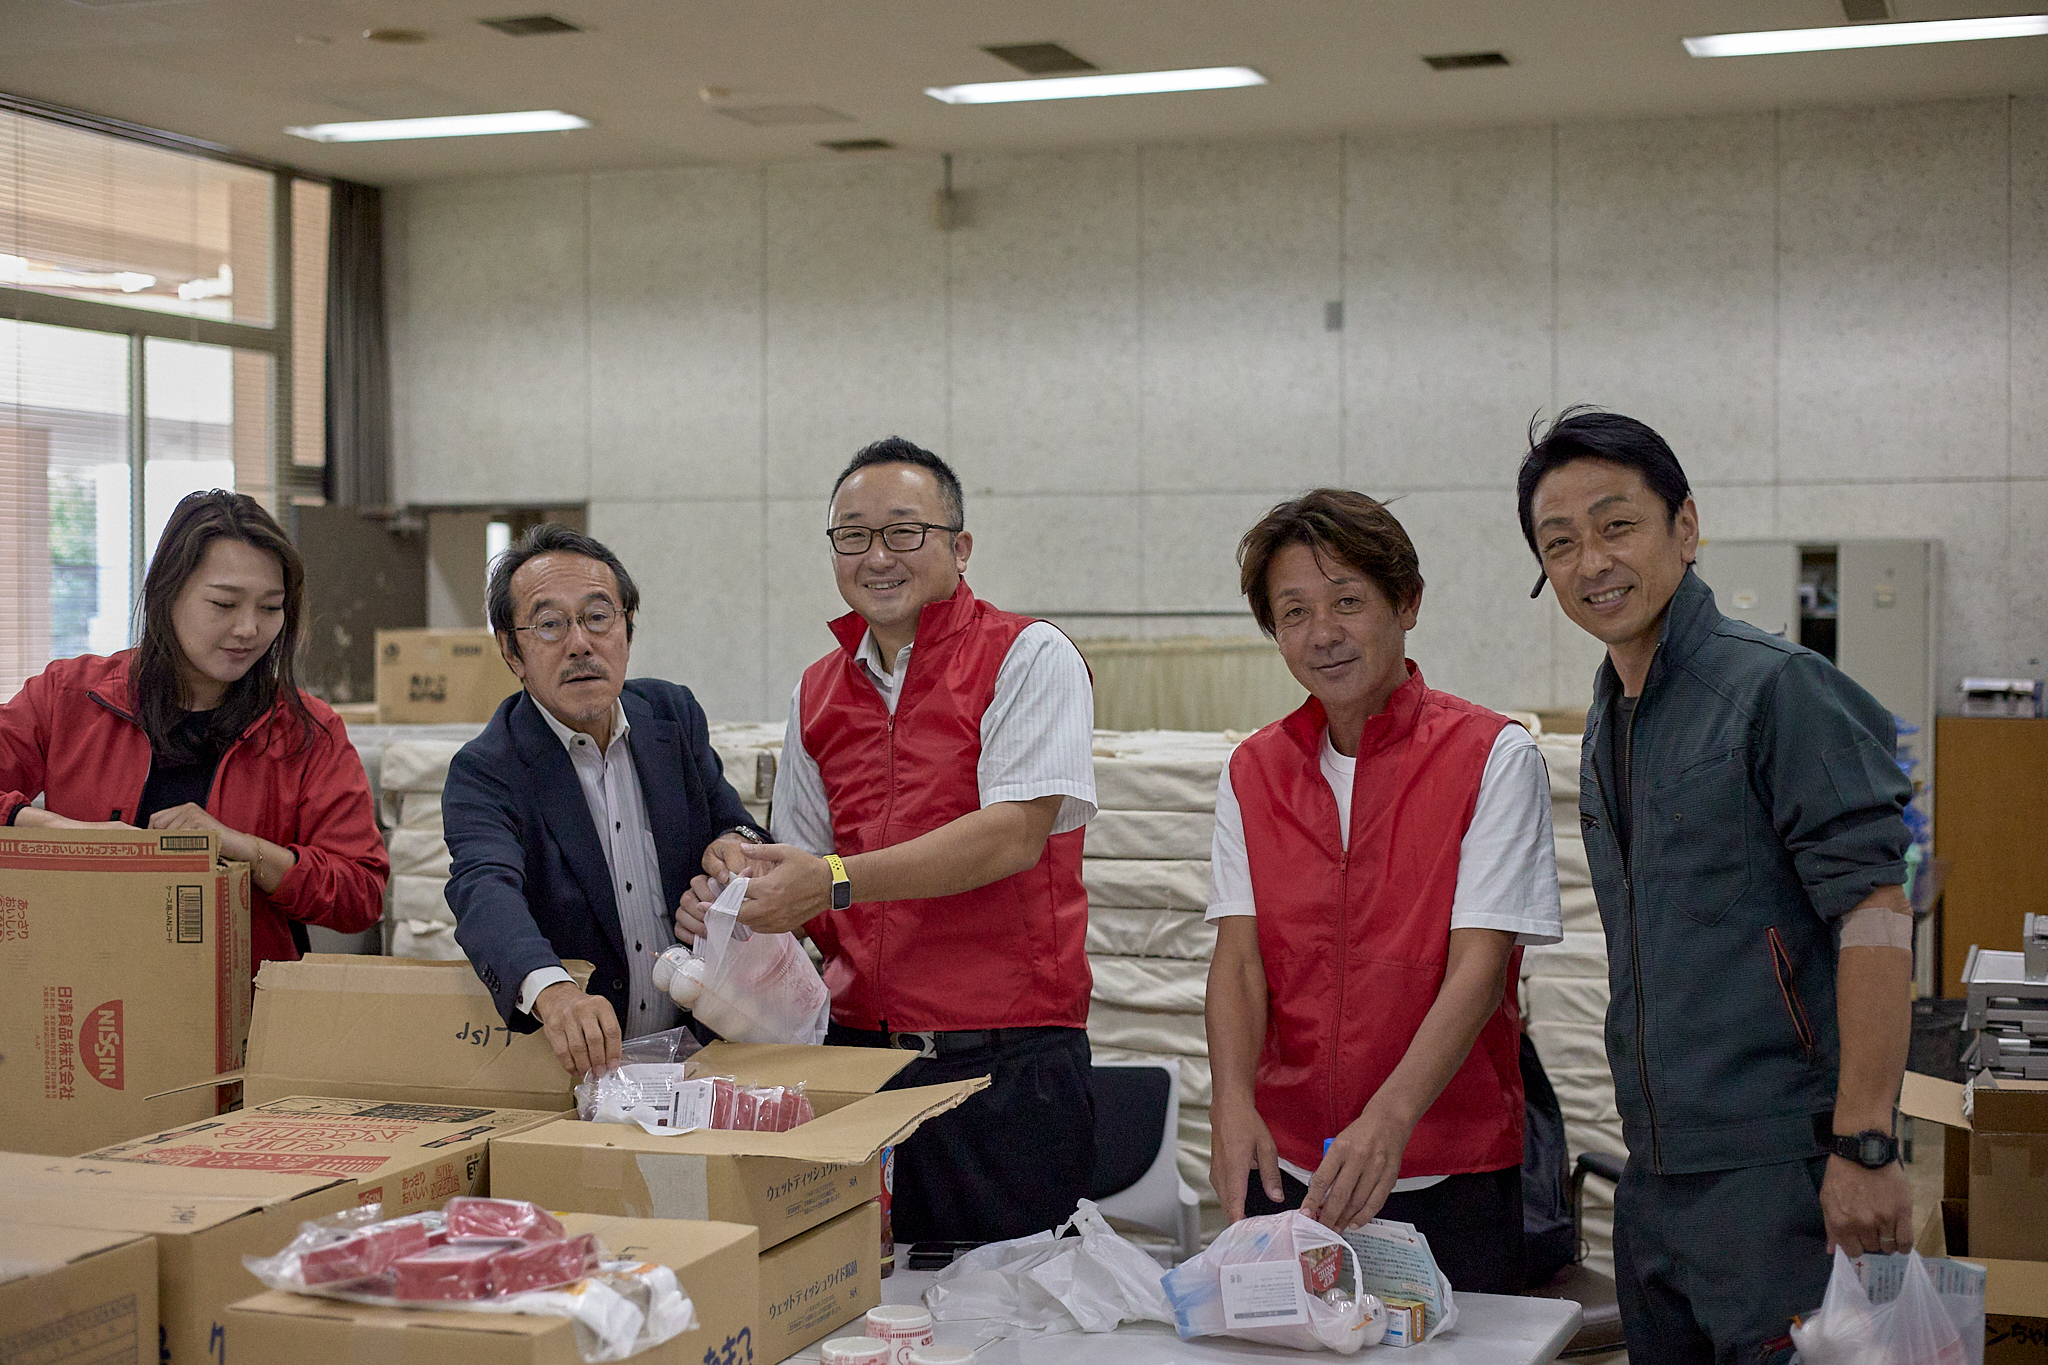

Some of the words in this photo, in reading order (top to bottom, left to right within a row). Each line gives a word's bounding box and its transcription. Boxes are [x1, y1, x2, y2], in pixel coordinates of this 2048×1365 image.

[21, 843, 137, 856] あっさりおいしいカップヌードル
[5, 896, 17, 942] おいしい
[17, 898, 30, 940] あっさり
[165, 885, 173, 944] ケース用JANコード
[57, 986, 75, 1100] 日清食品株式会社
[94, 1009, 120, 1080] NISSIN
[401, 1171, 426, 1190] あっさり
[435, 1163, 454, 1180] CUP
[401, 1186, 429, 1204] おいしい
